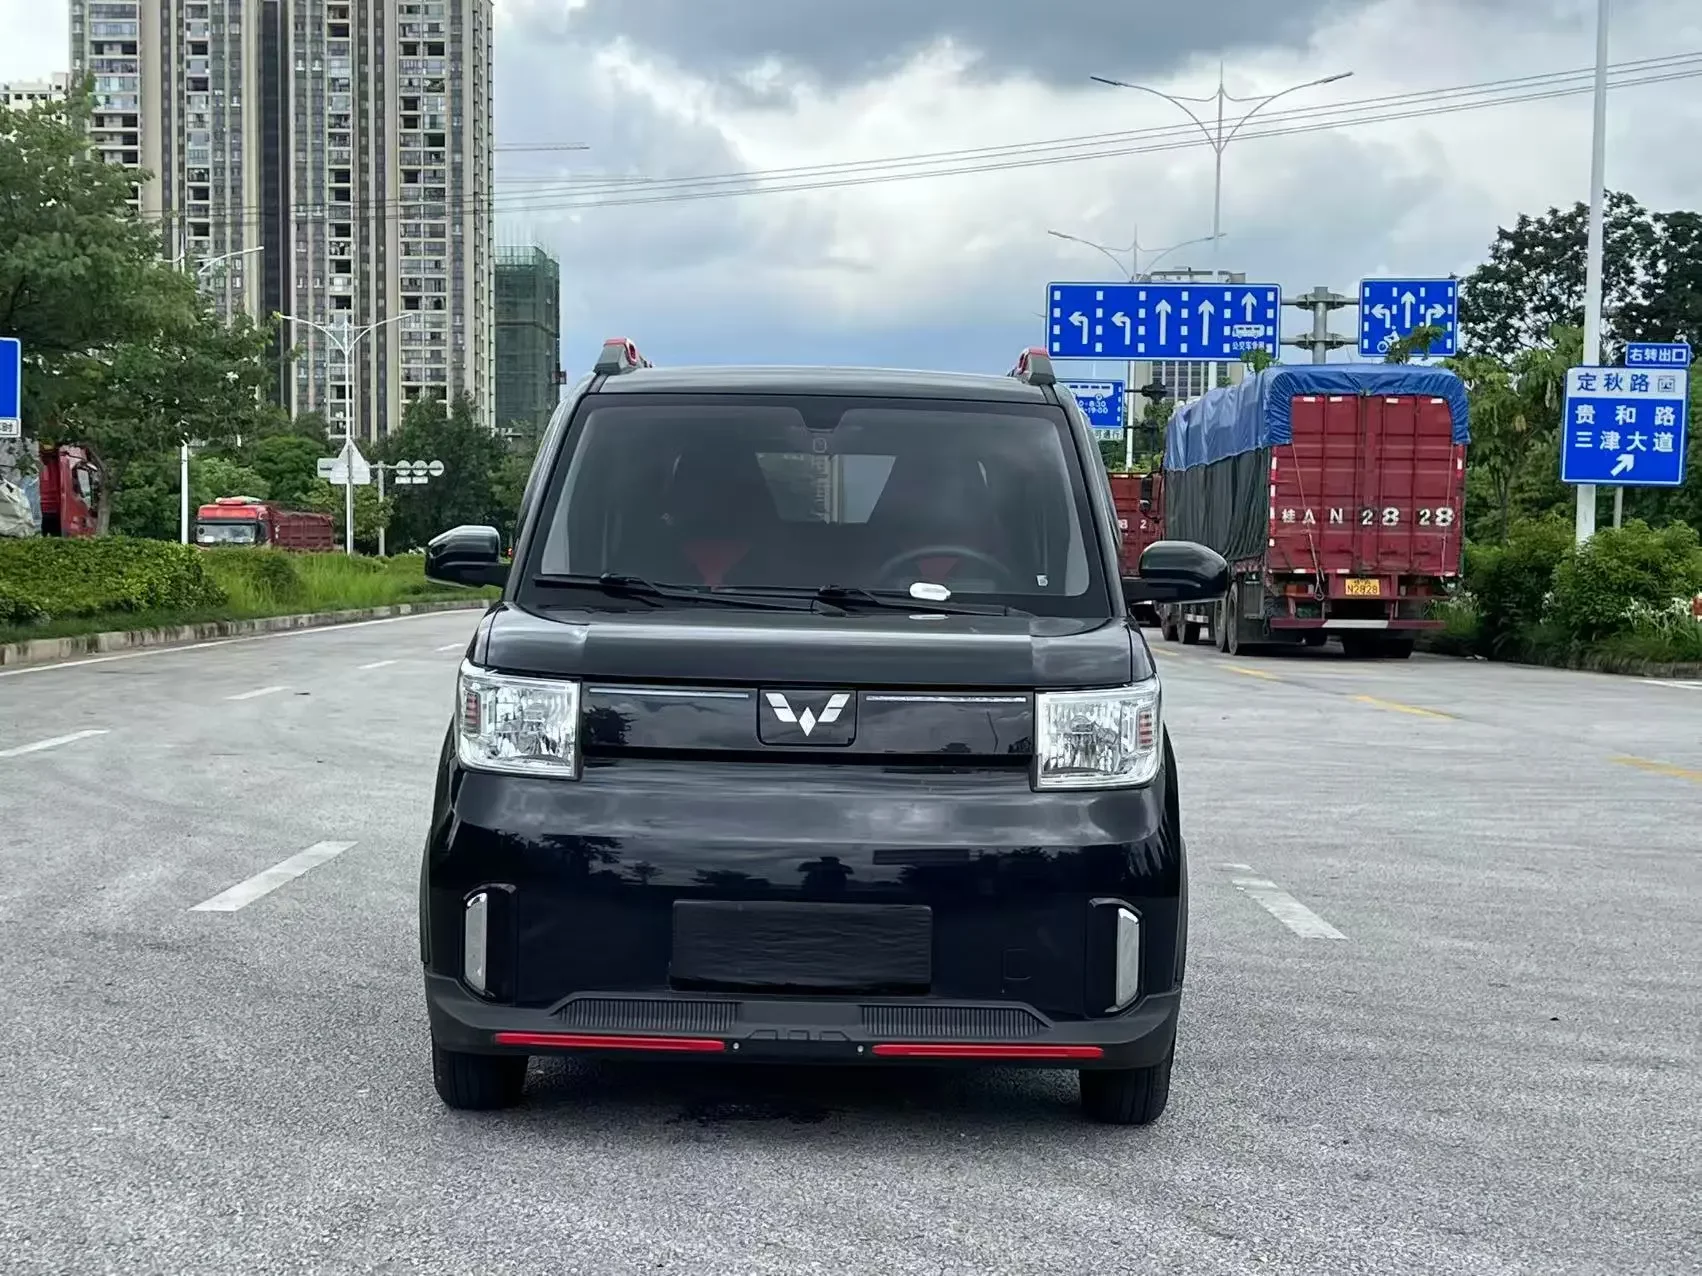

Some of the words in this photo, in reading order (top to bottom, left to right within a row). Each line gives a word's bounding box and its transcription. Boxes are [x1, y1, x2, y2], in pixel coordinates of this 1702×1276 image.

[1629, 348, 1687, 362] 右转出口
[1576, 372, 1650, 393] 定秋路
[1575, 404, 1676, 426] 贵和路
[1574, 430, 1674, 452] 三津大道
